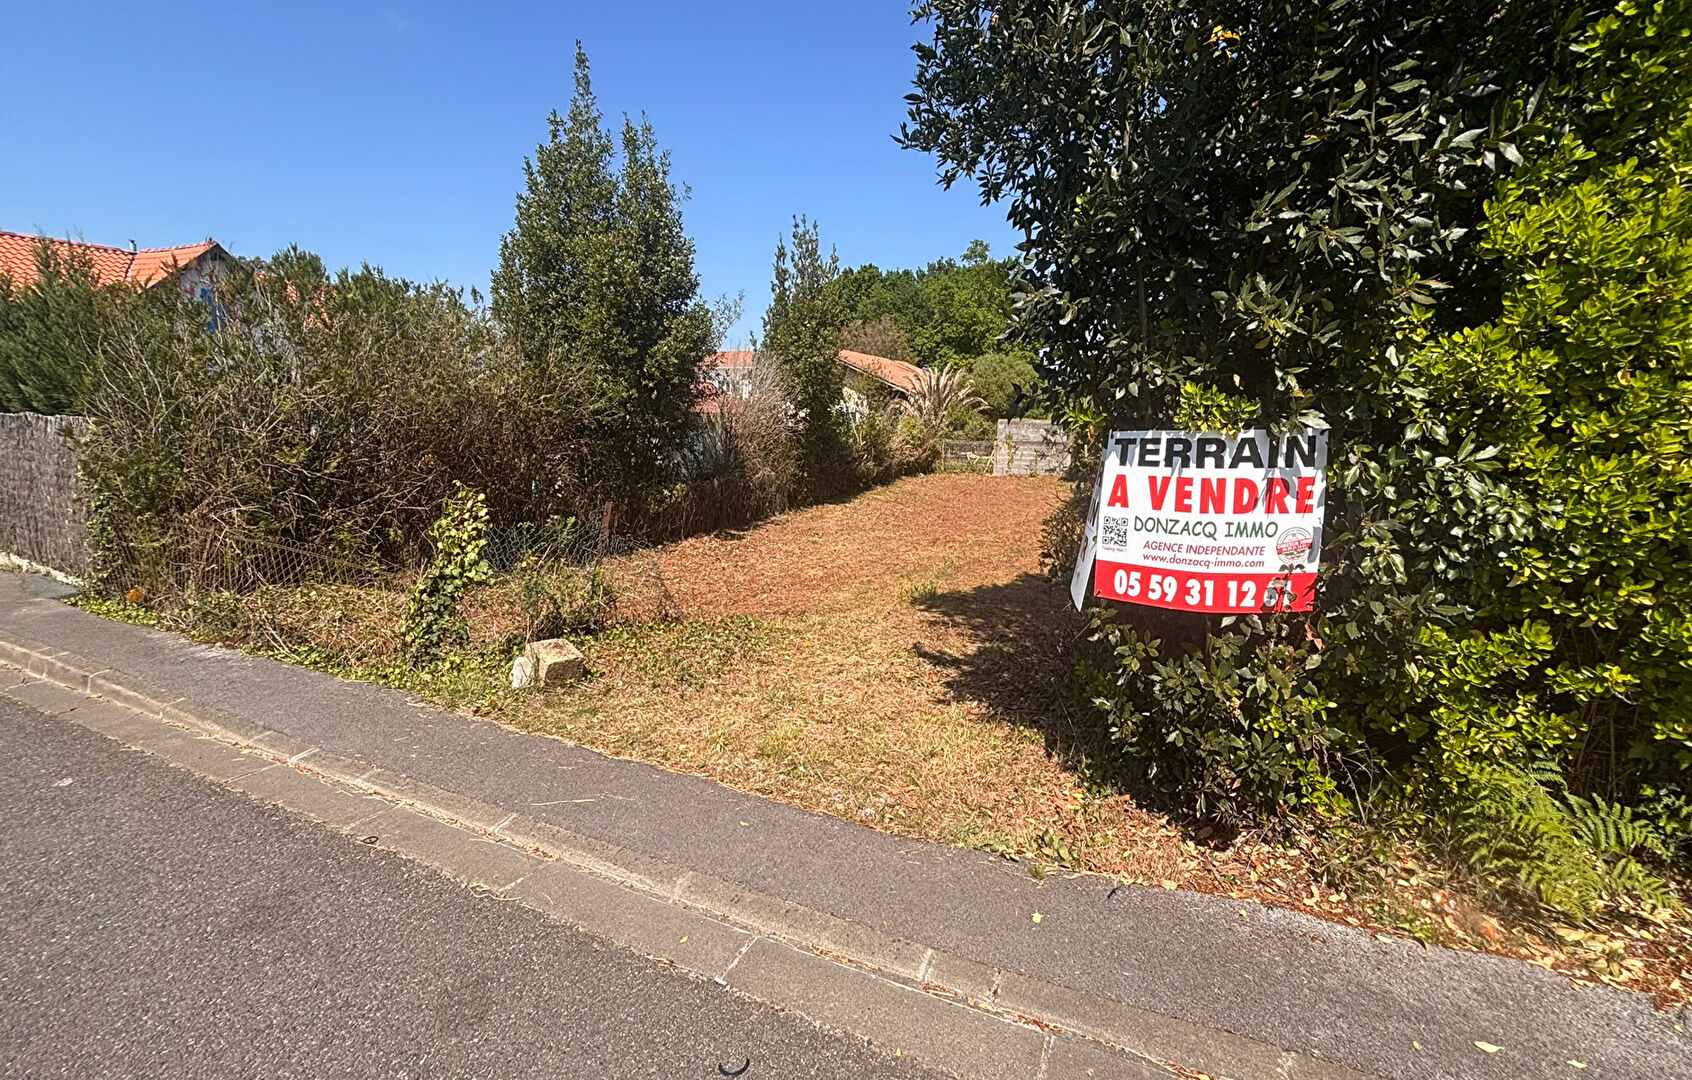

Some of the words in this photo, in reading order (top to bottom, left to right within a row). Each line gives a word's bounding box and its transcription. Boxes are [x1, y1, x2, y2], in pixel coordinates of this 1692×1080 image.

[1114, 435, 1317, 469] TERRAIN
[1107, 474, 1129, 509] A
[1148, 475, 1316, 514] VENDRE
[1134, 515, 1217, 541] DONZACQ
[1224, 521, 1278, 538] IMMO
[1143, 540, 1183, 553] AGENCE
[1185, 544, 1265, 556] INDEPENDANTE
[1143, 554, 1265, 569] www.donzacq-immo.com
[1114, 569, 1141, 597] 05
[1148, 573, 1177, 601] 59
[1185, 579, 1213, 606] 31
[1228, 580, 1256, 607] 12
